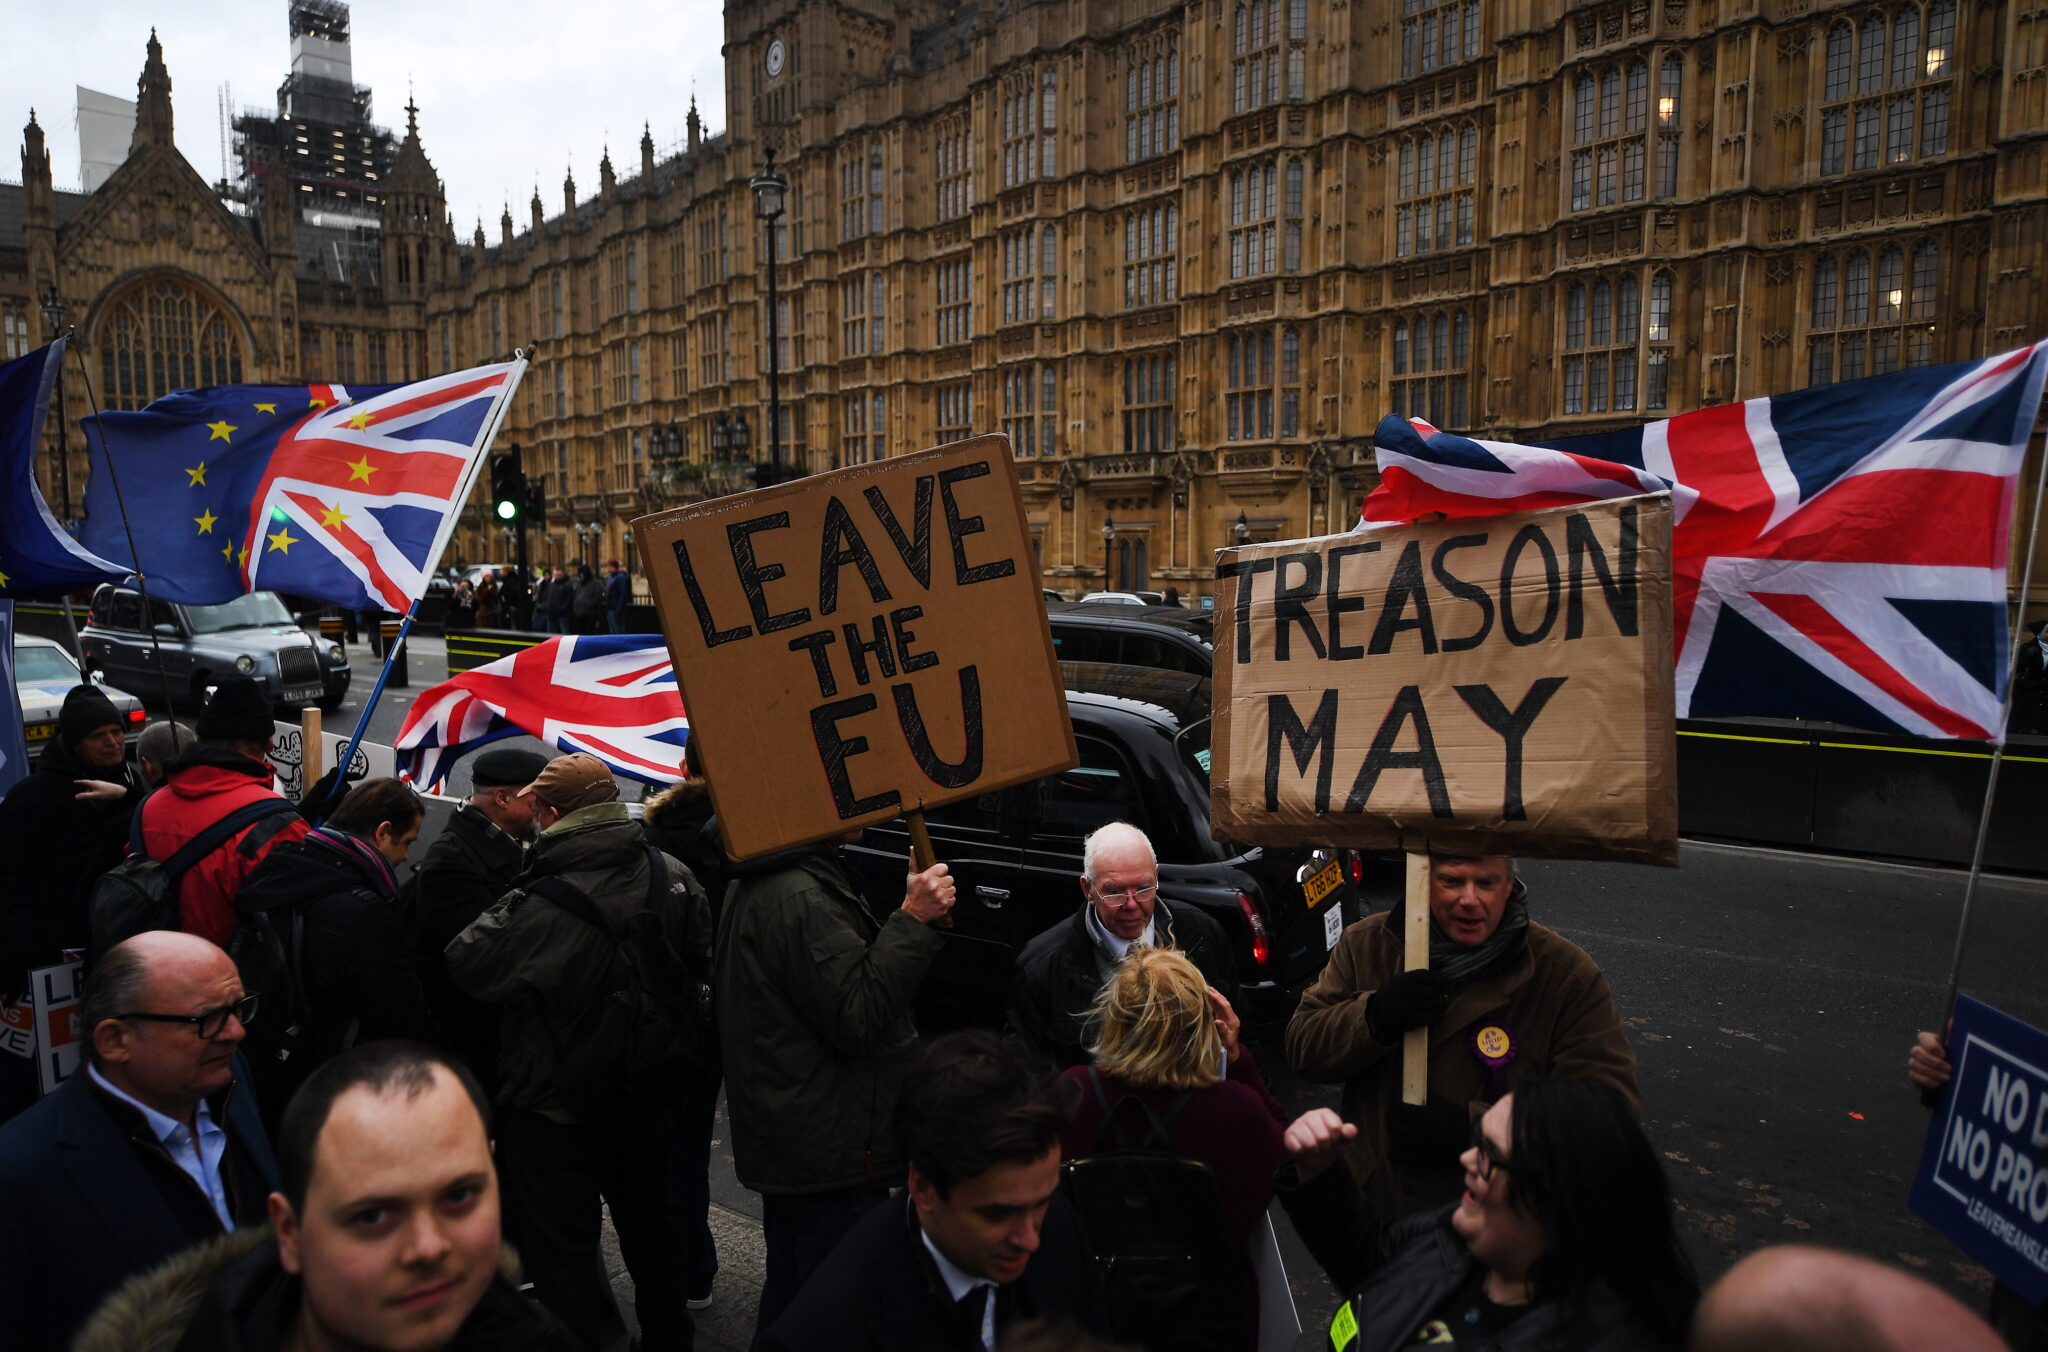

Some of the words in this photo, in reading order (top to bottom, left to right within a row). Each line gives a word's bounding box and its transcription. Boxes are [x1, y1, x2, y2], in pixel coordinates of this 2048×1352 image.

[672, 461, 1016, 648] LEAVE
[1217, 506, 1639, 664] TREASON
[788, 605, 940, 698] THE
[810, 664, 984, 820] EU
[1264, 676, 1569, 821] MAY
[1947, 1114, 1991, 1181] NO
[1990, 1142, 2048, 1224] PRO
[1981, 1064, 2030, 1134] NO
